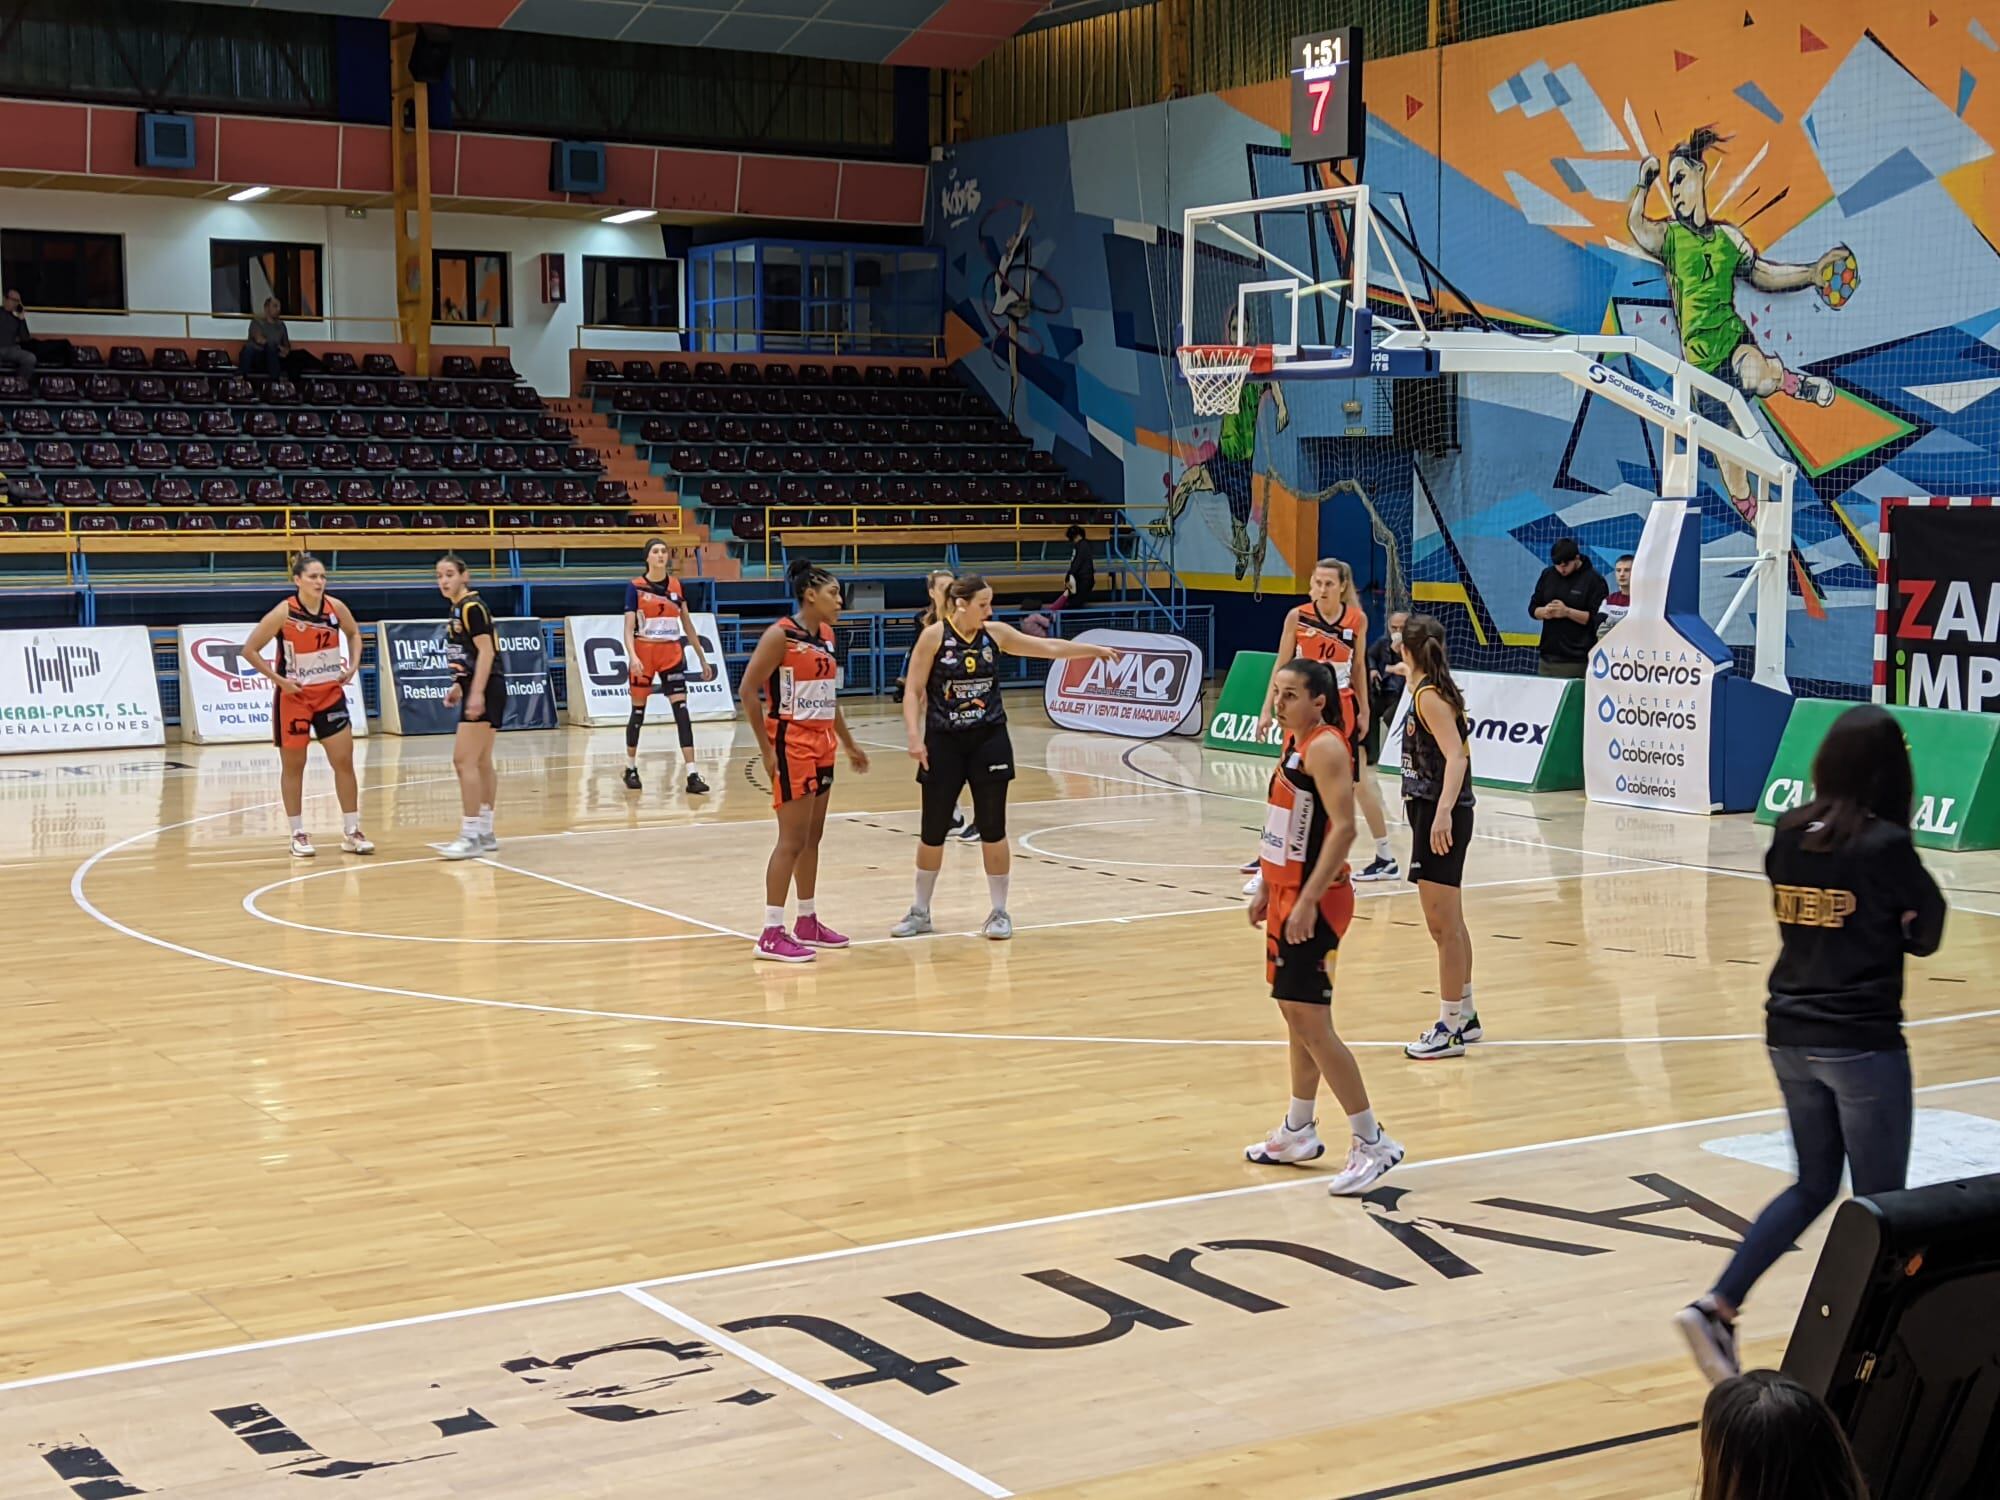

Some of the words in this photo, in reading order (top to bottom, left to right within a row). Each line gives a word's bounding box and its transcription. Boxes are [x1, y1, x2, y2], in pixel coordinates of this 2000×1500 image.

[1303, 37, 1341, 69] 1:51
[1307, 80, 1331, 132] 7
[1608, 374, 1646, 400] Schelde
[1646, 394, 1676, 416] Sports
[315, 631, 332, 650] 12
[421, 639, 449, 653] PALA
[500, 637, 540, 652] DUERO
[1318, 642, 1336, 660] 10
[1611, 647, 1702, 664] LÁCTEAS
[423, 655, 448, 670] ZAM
[965, 656, 977, 673] 9
[1065, 653, 1175, 700] AMAQ
[1611, 660, 1701, 685] cobreros
[228, 678, 276, 692] CENT
[403, 685, 453, 699] Restaur
[688, 684, 723, 694] RUCES
[117, 702, 147, 717] S.L.
[216, 703, 235, 711] ALTO
[250, 702, 261, 710] LA
[1617, 694, 1697, 710] LÁCTEAS
[1049, 700, 1086, 716] ALQUILER
[1087, 703, 1092, 716] Y
[1094, 704, 1119, 718] VENTA
[1121, 707, 1132, 720] DE
[1132, 708, 1182, 723] MAQUINARIA
[1616, 706, 1696, 730] cobreros
[0, 719, 149, 736] EÑALIZACIONES
[1622, 738, 1685, 752] LÁCTEAS
[1622, 747, 1685, 767] cobreros
[1627, 775, 1676, 786] LÁCTEAS
[1627, 781, 1677, 798] cobreros
